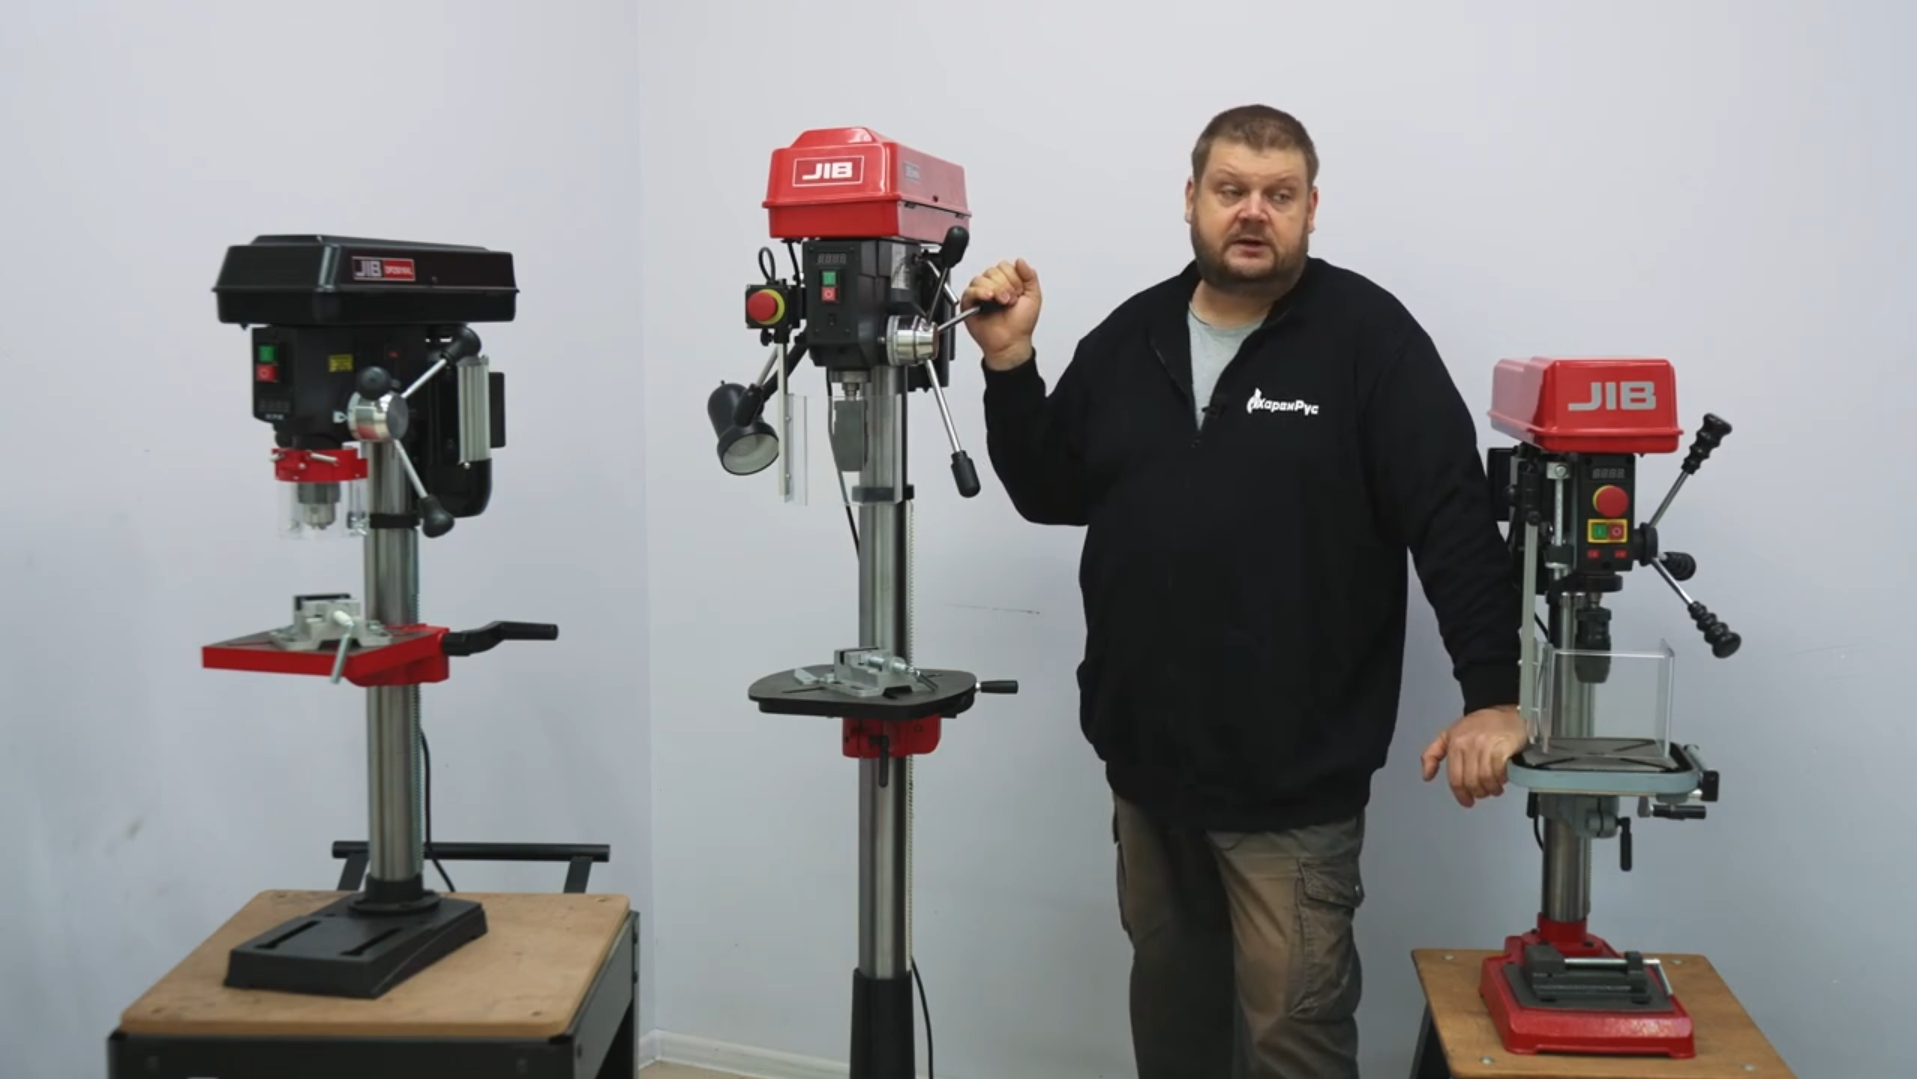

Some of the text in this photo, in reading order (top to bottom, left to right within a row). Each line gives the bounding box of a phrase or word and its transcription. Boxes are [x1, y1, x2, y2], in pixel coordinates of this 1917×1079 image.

[802, 162, 852, 180] JIB
[355, 260, 382, 277] JIB
[1568, 381, 1656, 411] JIB
